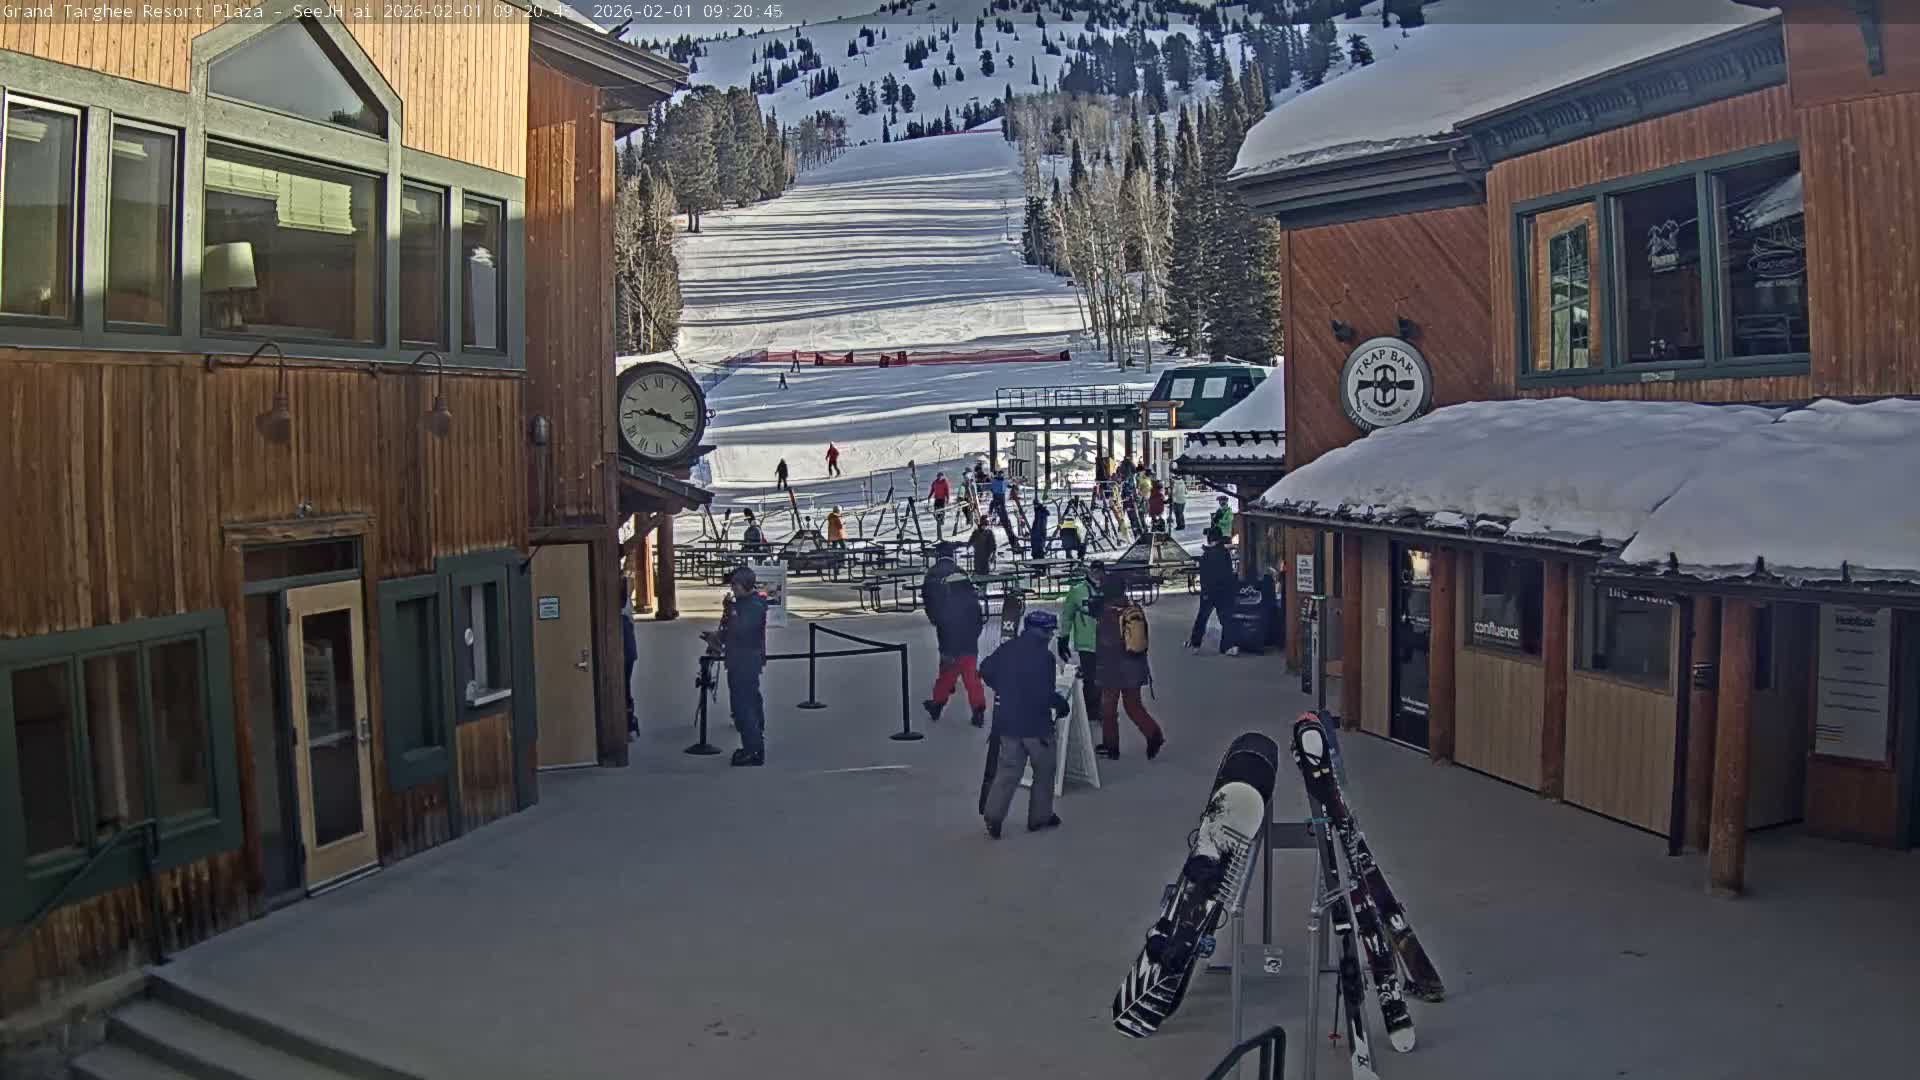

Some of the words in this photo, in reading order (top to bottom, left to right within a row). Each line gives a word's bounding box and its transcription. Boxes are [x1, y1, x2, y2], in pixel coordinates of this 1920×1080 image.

[1356, 349, 1386, 376] TRAP
[1390, 351, 1414, 375] BAR
[1473, 620, 1520, 640] confluence
